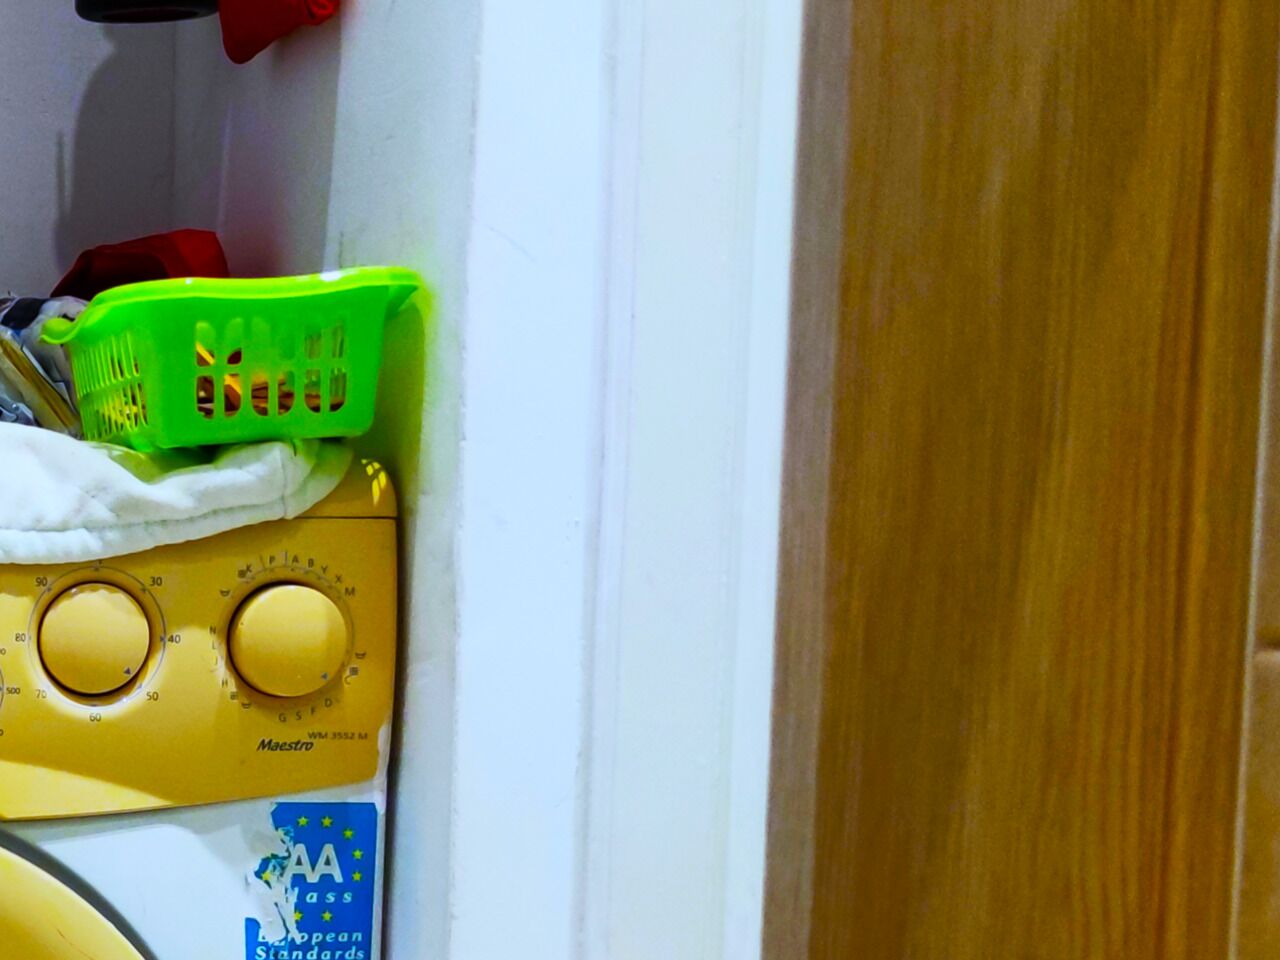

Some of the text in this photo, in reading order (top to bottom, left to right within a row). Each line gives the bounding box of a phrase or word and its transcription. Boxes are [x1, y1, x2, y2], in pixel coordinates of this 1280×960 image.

[269, 555, 276, 565] P
[291, 554, 299, 564] A
[307, 558, 314, 568] B
[320, 564, 328, 574] Y
[35, 577, 48, 587] 90
[149, 576, 163, 587] 30
[334, 574, 342, 584] X
[344, 587, 355, 597] M
[15, 633, 26, 642] 80
[167, 634, 181, 644] 40
[6, 687, 21, 695] 500
[35, 689, 47, 699] 70
[146, 691, 159, 702] 50
[324, 698, 333, 707] D
[89, 713, 102, 722] 60
[278, 713, 287, 723] G
[295, 711, 302, 721] S
[308, 732, 328, 740] WM
[358, 732, 368, 740] M
[256, 739, 314, 752] Maestro
[291, 887, 353, 904] lass
[254, 946, 366, 960] Standards
